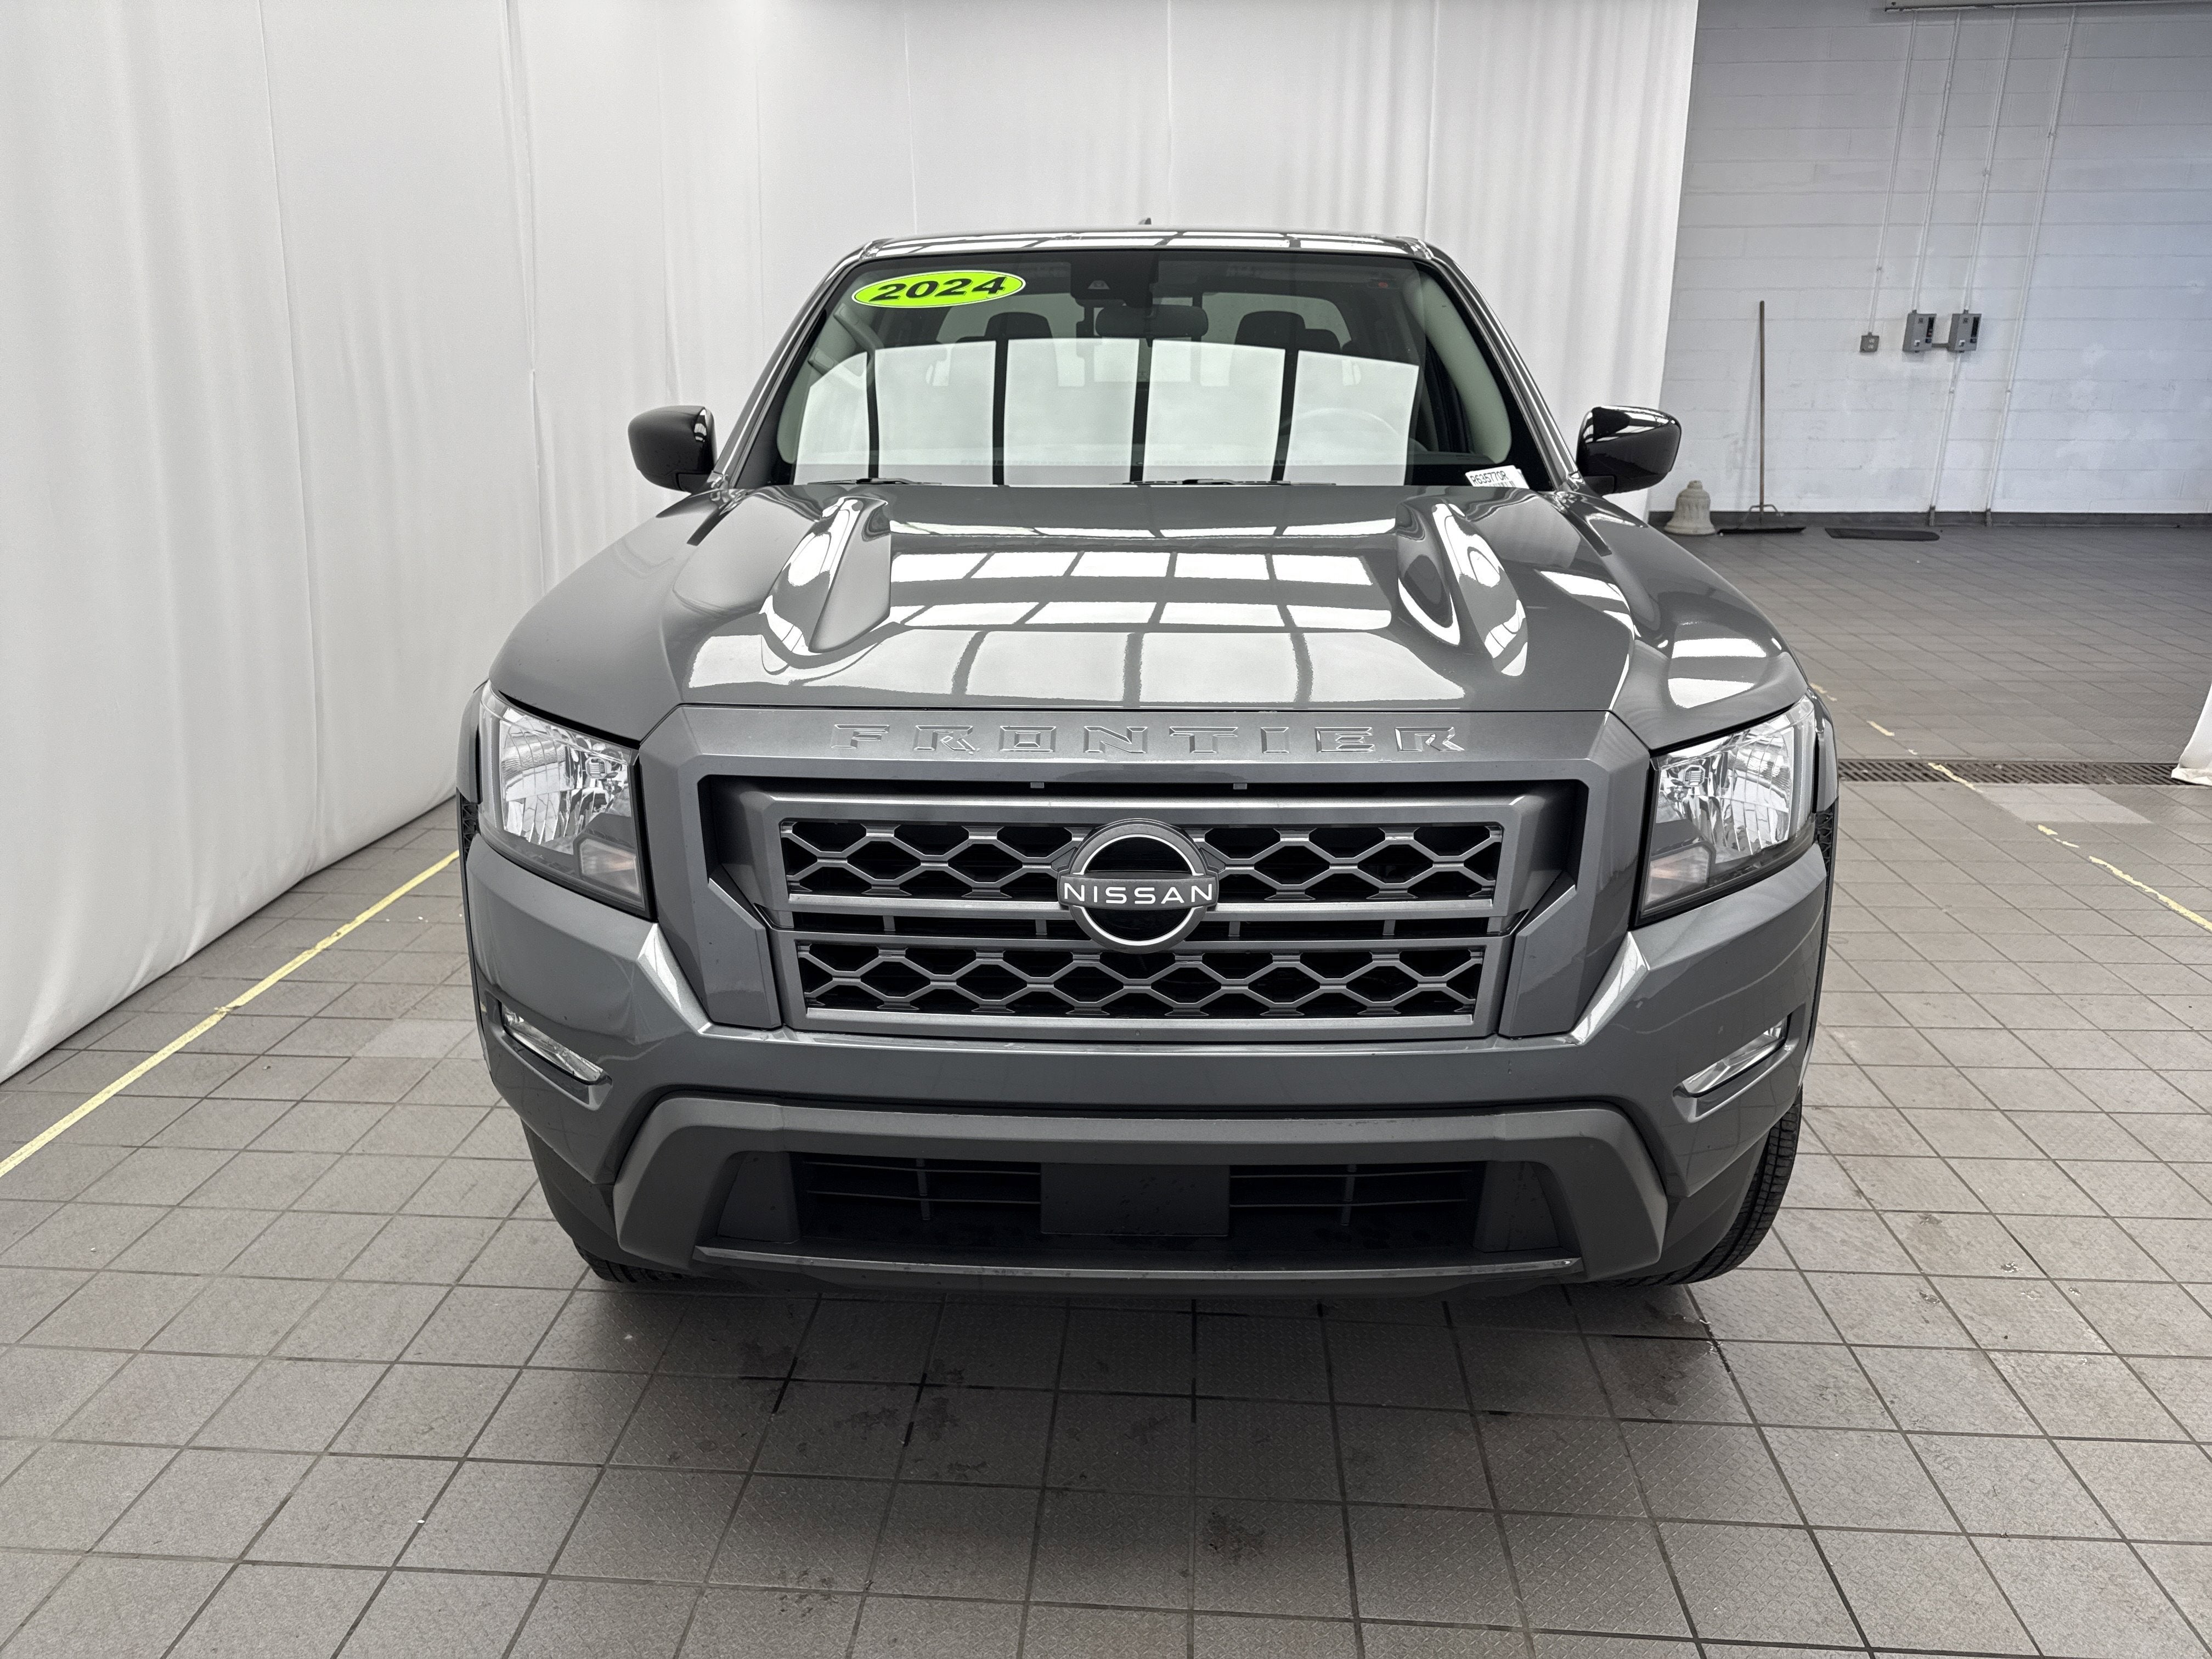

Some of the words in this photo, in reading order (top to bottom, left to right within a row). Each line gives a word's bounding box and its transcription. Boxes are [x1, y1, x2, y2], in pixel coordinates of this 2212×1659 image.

[869, 276, 1007, 301] 2024
[831, 724, 1465, 753] FRONTIER
[1064, 882, 1212, 905] NISSAN
